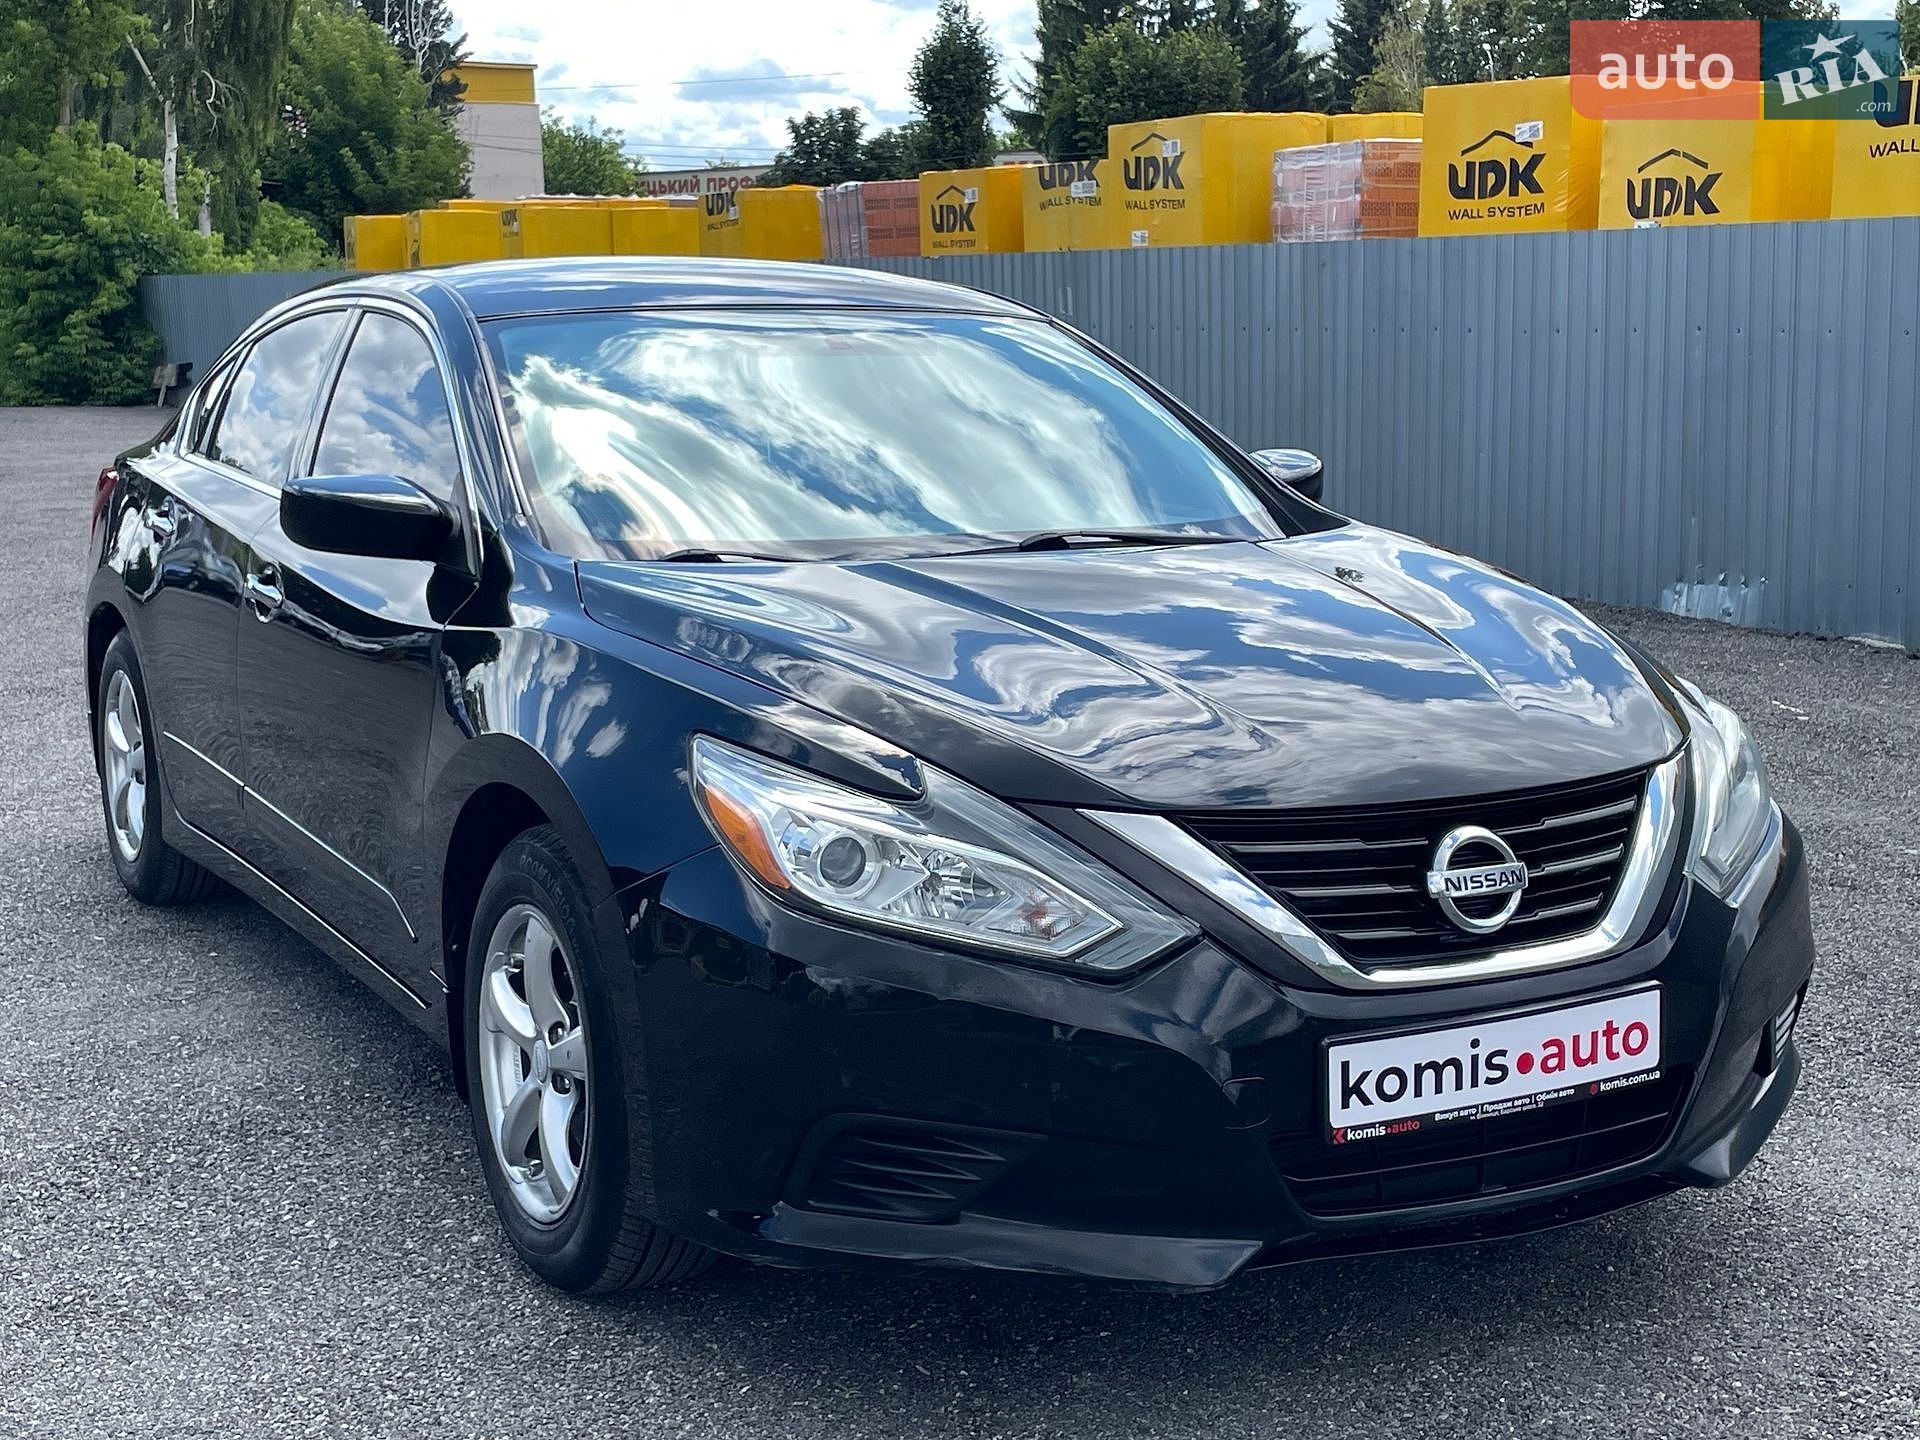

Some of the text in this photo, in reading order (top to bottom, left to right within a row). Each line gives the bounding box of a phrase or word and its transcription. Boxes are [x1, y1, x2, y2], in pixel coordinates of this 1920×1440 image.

[1873, 79, 1920, 128] U
[1038, 160, 1101, 190] UDK
[1123, 151, 1186, 191] UDK
[1448, 152, 1547, 200] UDK
[705, 192, 737, 217] UDK
[1039, 196, 1102, 211] WALL SYSTEM
[1125, 199, 1186, 210] WALL SYSTEM
[1626, 172, 1723, 219] UDK
[931, 203, 976, 233] UDK
[1448, 202, 1545, 220] WALL SYSTEM
[932, 239, 976, 249] WALL SYSTEM
[1444, 869, 1523, 892] NISSAN
[1600, 1071, 1661, 1092] komis.com.ua
